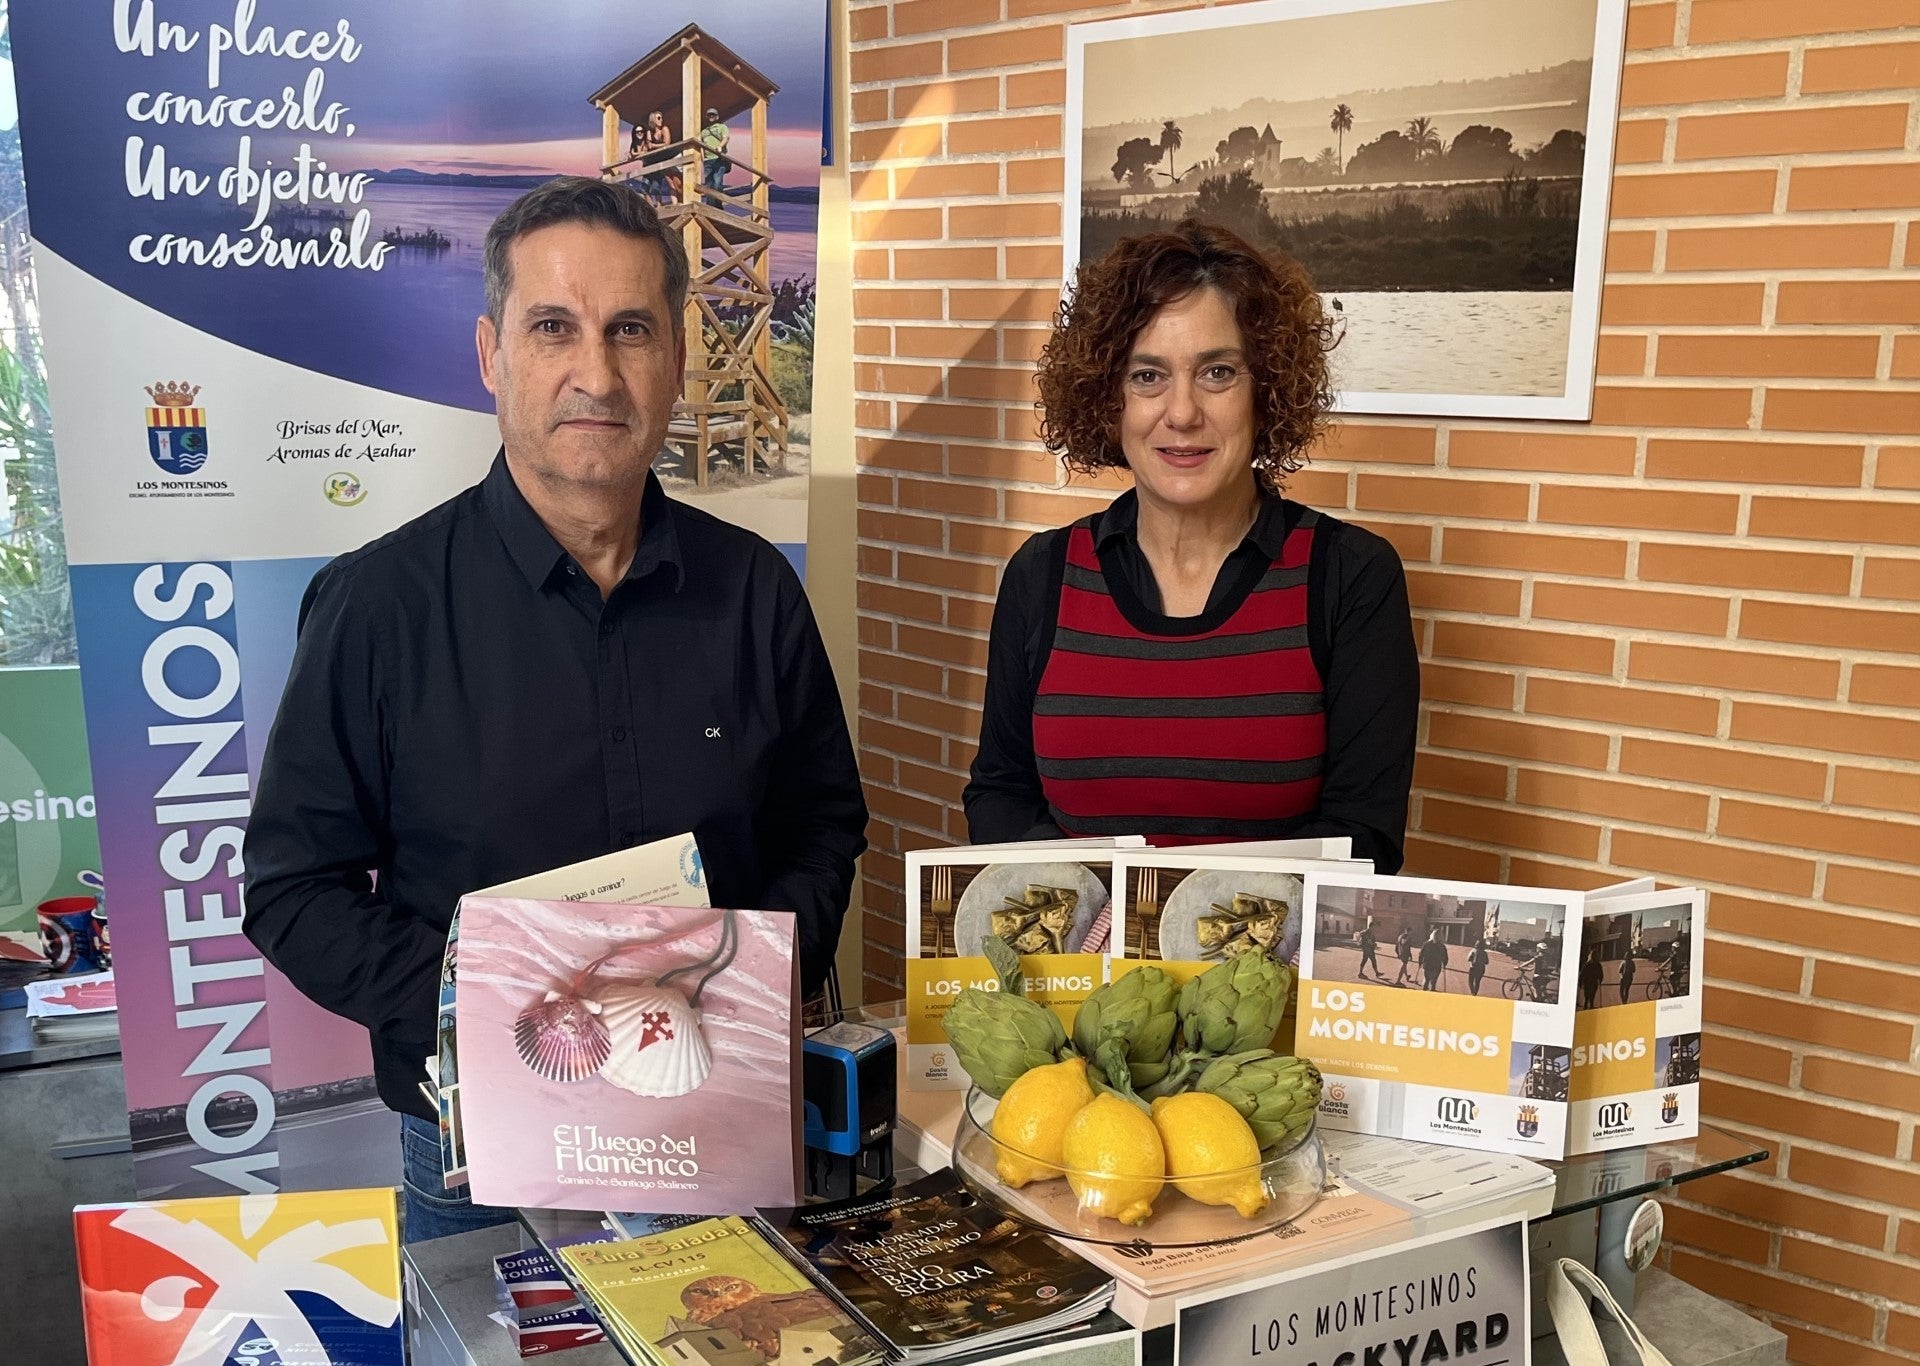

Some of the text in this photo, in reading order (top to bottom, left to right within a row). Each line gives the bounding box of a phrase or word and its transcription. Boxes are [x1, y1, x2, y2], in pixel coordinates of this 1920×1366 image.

[113, 0, 361, 89] Un placer
[126, 67, 355, 137] conocerlo,
[125, 135, 374, 231] Un objetivo
[129, 208, 395, 271] conservarlo
[276, 419, 403, 439] Brisas del Mar,
[266, 443, 416, 464] Aromas de Azahar
[136, 481, 228, 490] LOS MONTESINOS
[705, 727, 721, 738] CK
[926, 976, 1093, 996] LOS MOESINOS
[1311, 988, 1366, 1013] LOS
[1309, 1016, 1500, 1057] MONTESINOS
[1573, 1037, 1646, 1067] SINOS
[1318, 1106, 1349, 1115] Blanca
[1323, 1100, 1348, 1109] Costa
[1430, 1121, 1441, 1129] Los
[1442, 1123, 1482, 1134] Montesinos
[1593, 1129, 1602, 1138] Los
[1603, 1126, 1635, 1136] Montesinos
[554, 1124, 696, 1157] El Juego del
[555, 1145, 699, 1177] Flamenco
[557, 1174, 699, 1190] Camino de Santiago Salinero
[572, 1247, 641, 1266] Ruta
[638, 1228, 730, 1256] Salada
[843, 1219, 958, 1253] XXI JORNADAS
[881, 1235, 940, 1255] TEATRO
[860, 1231, 982, 1268] UNIVERSITARIO
[1135, 1256, 1166, 1267] Vega
[1166, 1251, 1193, 1260] Baja
[1195, 1245, 1214, 1254] del
[629, 1252, 707, 1274] SL-CV 115
[631, 1264, 707, 1283] Montesinos
[871, 1261, 918, 1276] EN EL
[881, 1265, 944, 1287] BAJO
[894, 1265, 994, 1297] SEGURA
[1252, 1266, 1477, 1357] LOS MONTESINOS
